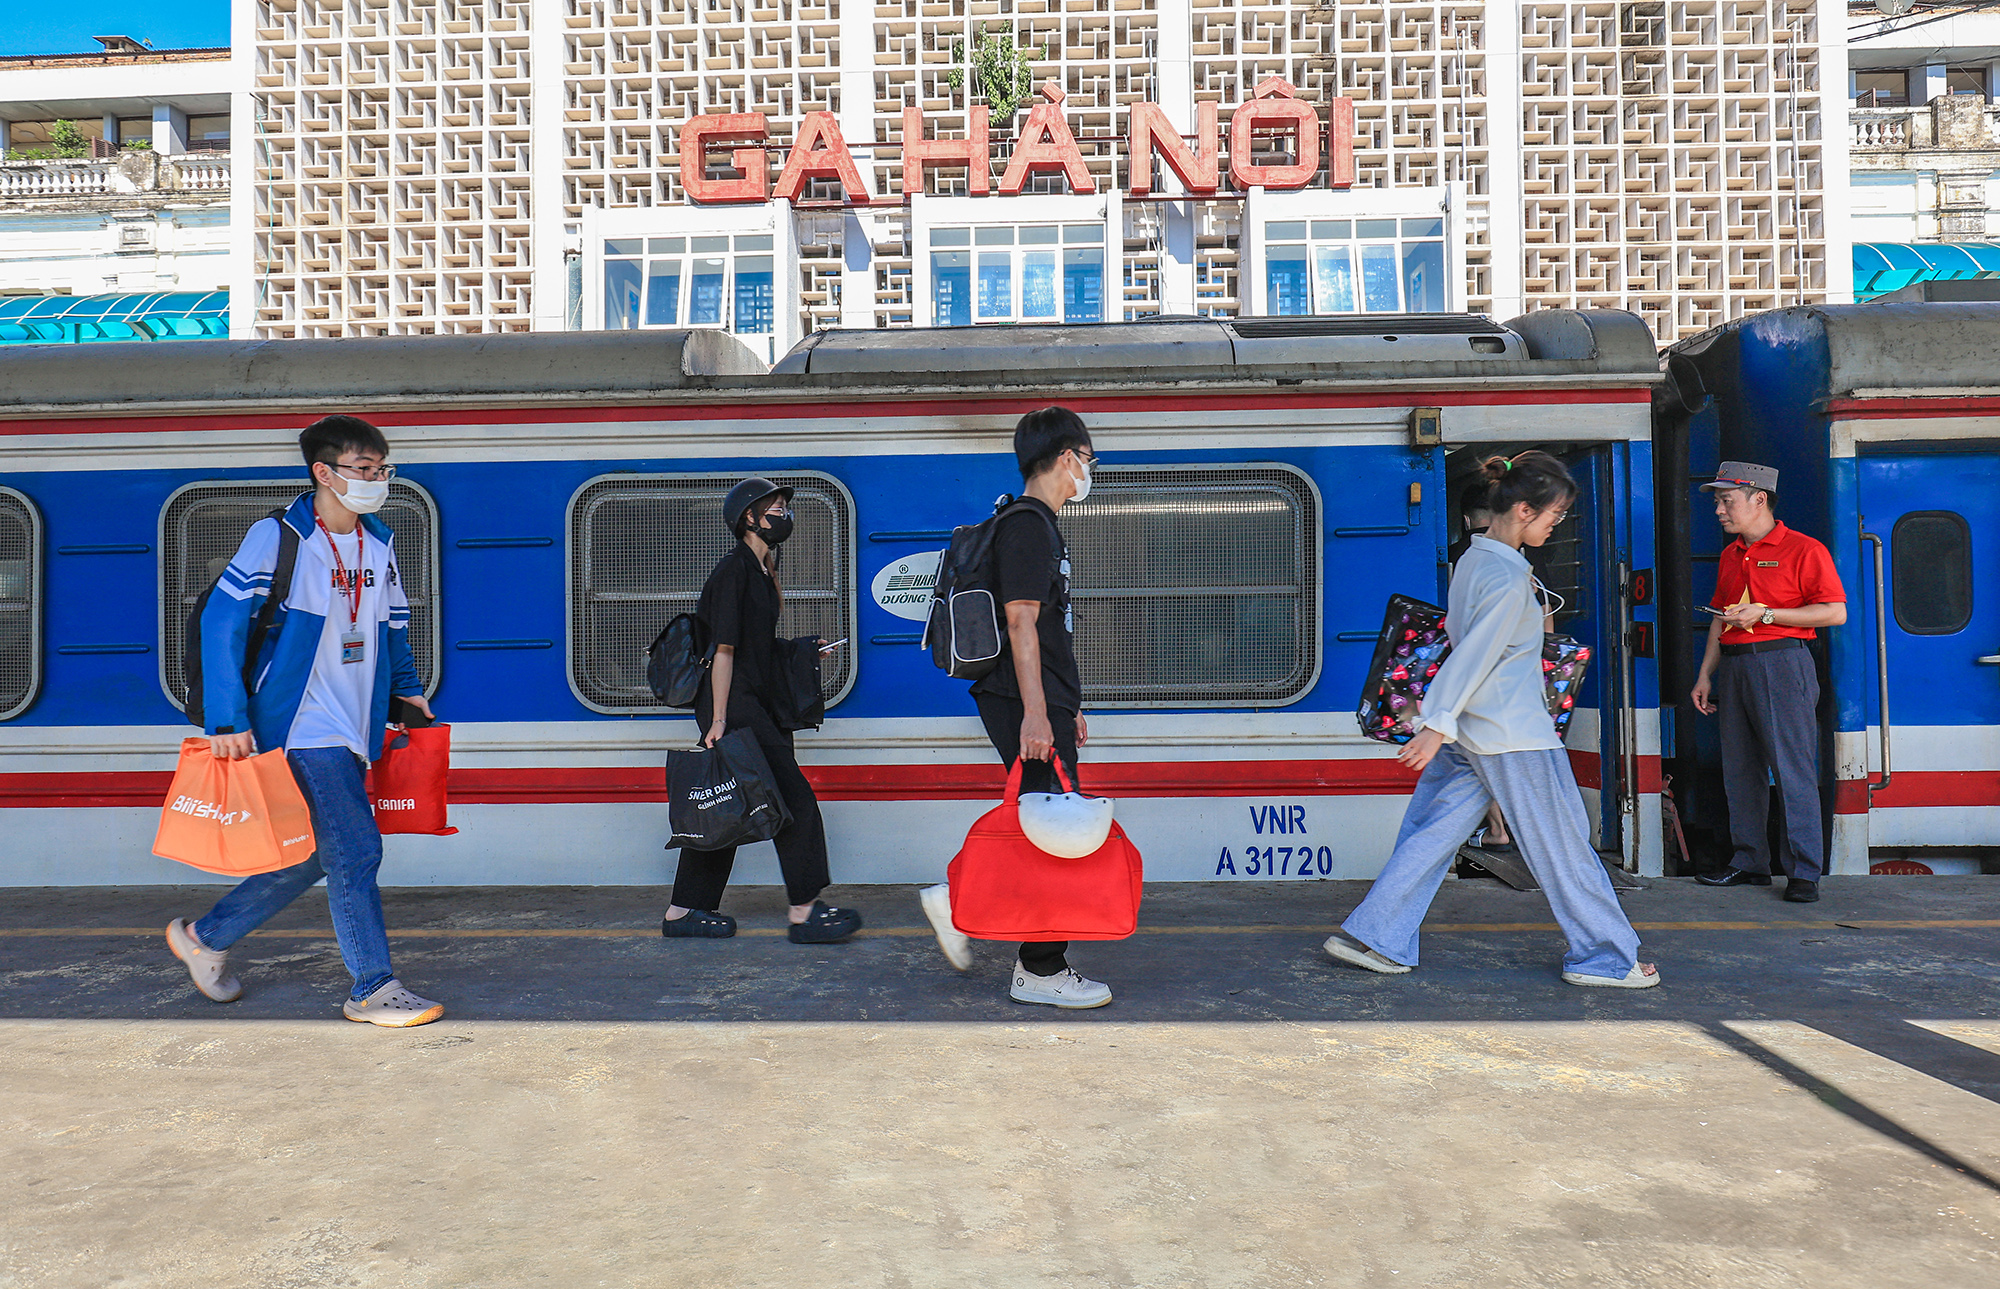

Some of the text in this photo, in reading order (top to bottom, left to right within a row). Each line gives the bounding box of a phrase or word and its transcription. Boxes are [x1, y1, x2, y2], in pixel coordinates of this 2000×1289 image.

[679, 110, 870, 204] GA
[903, 80, 1095, 197] HÀ
[1634, 575, 1645, 600] 8
[1638, 626, 1646, 652] 7
[377, 798, 415, 811] CANIFA
[1249, 805, 1307, 834] VNR
[1216, 845, 1333, 875] A 31720
